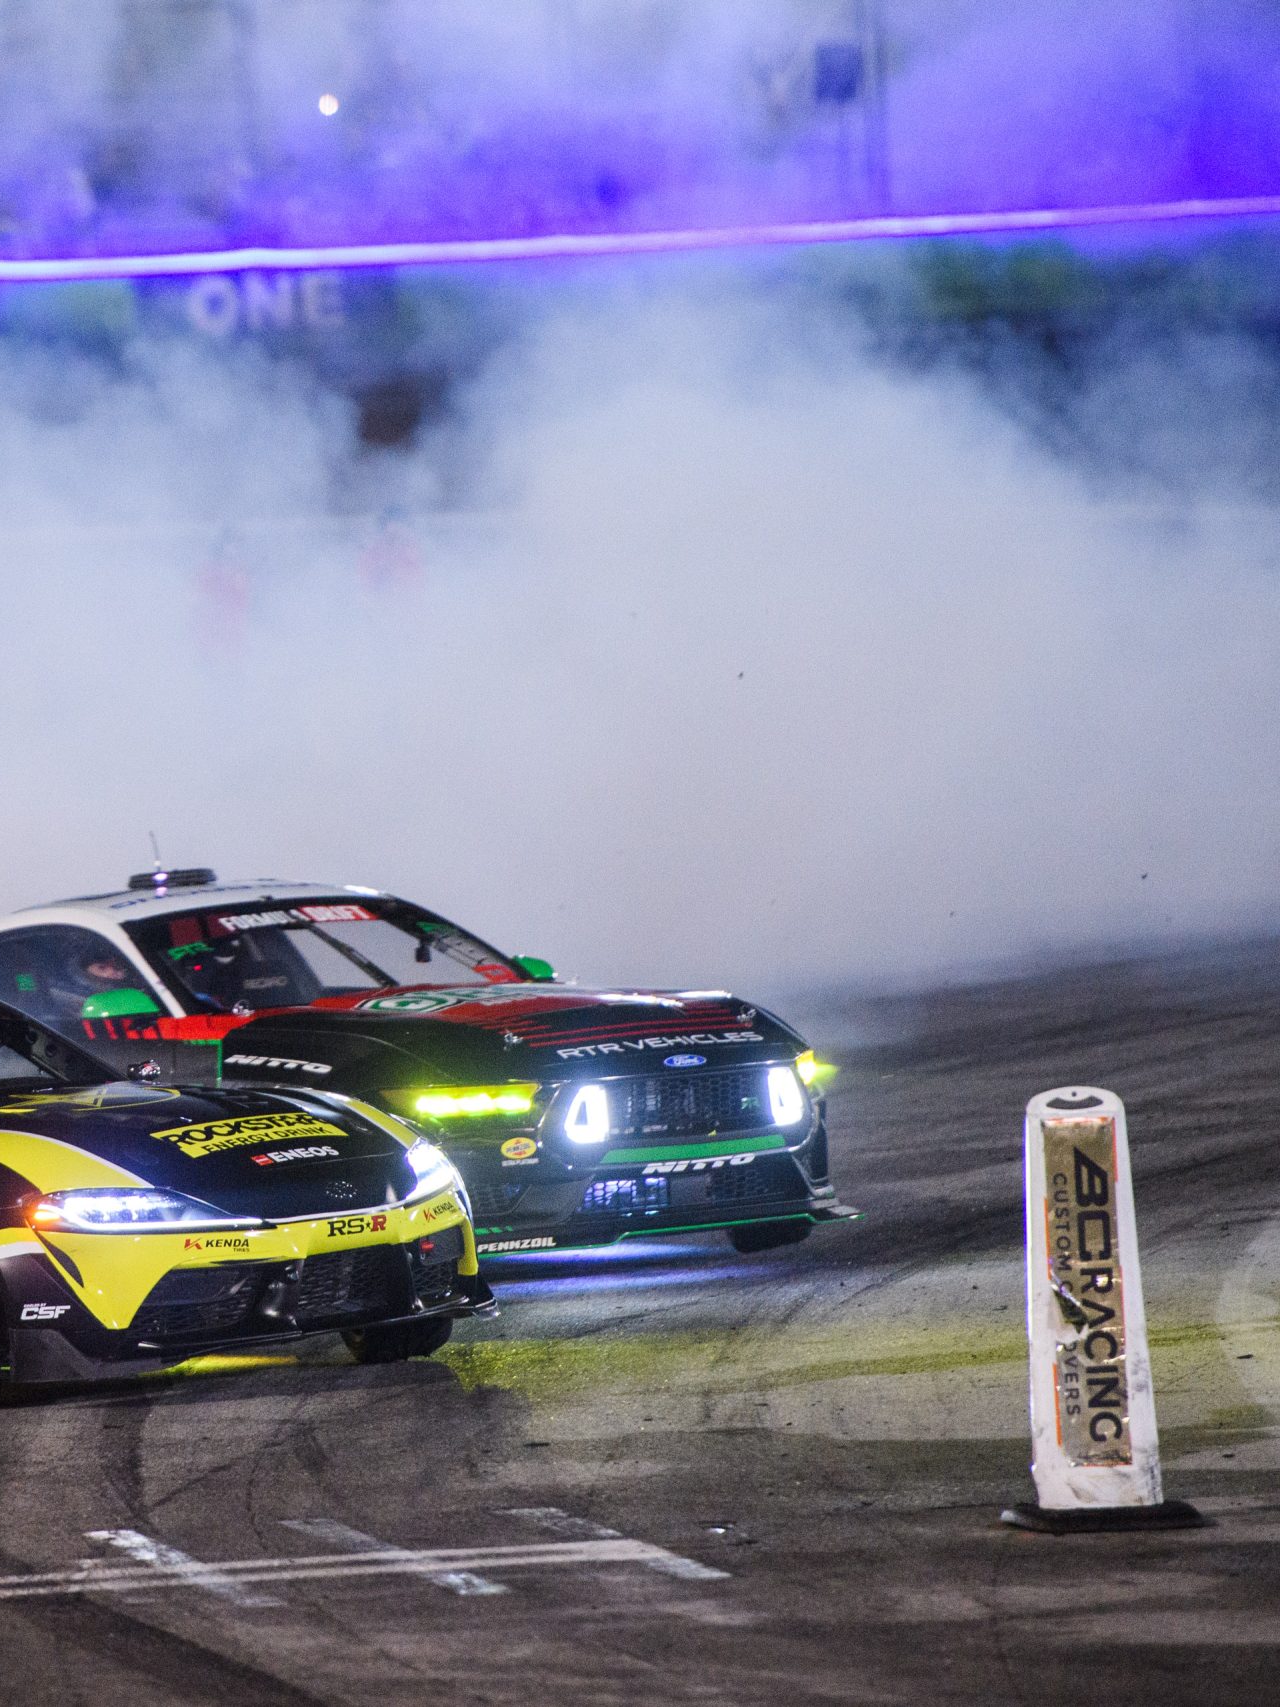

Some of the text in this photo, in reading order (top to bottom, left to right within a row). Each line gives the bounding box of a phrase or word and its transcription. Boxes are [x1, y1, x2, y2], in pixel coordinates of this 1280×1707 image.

[556, 1031, 764, 1059] RTR VEHICLES
[224, 1054, 332, 1074] NITTO
[202, 1125, 333, 1153] ENERGY DRINK
[267, 1145, 340, 1163] ENEOS
[642, 1153, 756, 1175] NITTO
[1053, 1173, 1072, 1271] CUSTOM
[205, 1239, 250, 1248] KENDA
[477, 1237, 557, 1253] PENNZOIL
[20, 1305, 71, 1320] CSF
